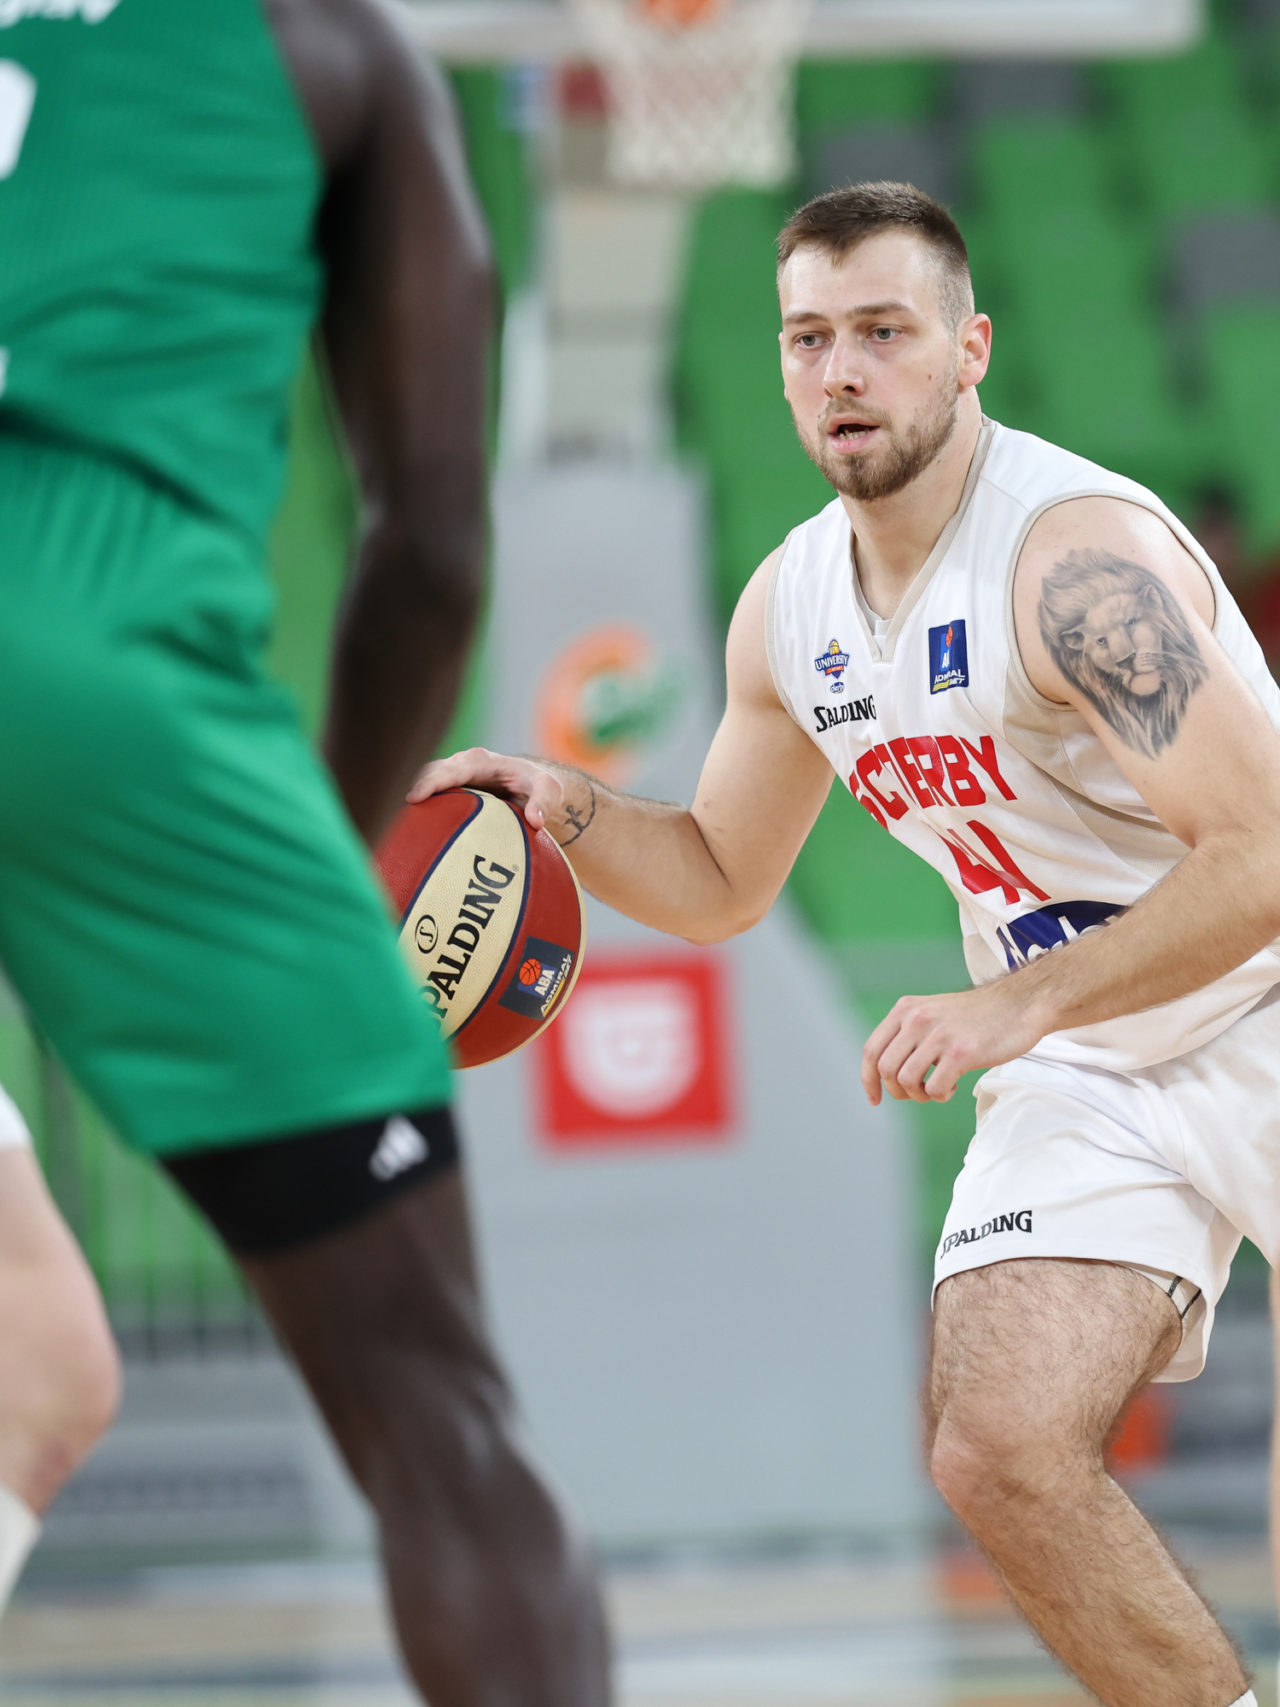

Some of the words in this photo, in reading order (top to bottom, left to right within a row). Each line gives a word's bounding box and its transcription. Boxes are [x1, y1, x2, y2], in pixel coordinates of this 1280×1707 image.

[417, 854, 517, 1026] PALDING
[535, 969, 555, 997] ABA
[940, 1210, 1032, 1260] SPALDING
